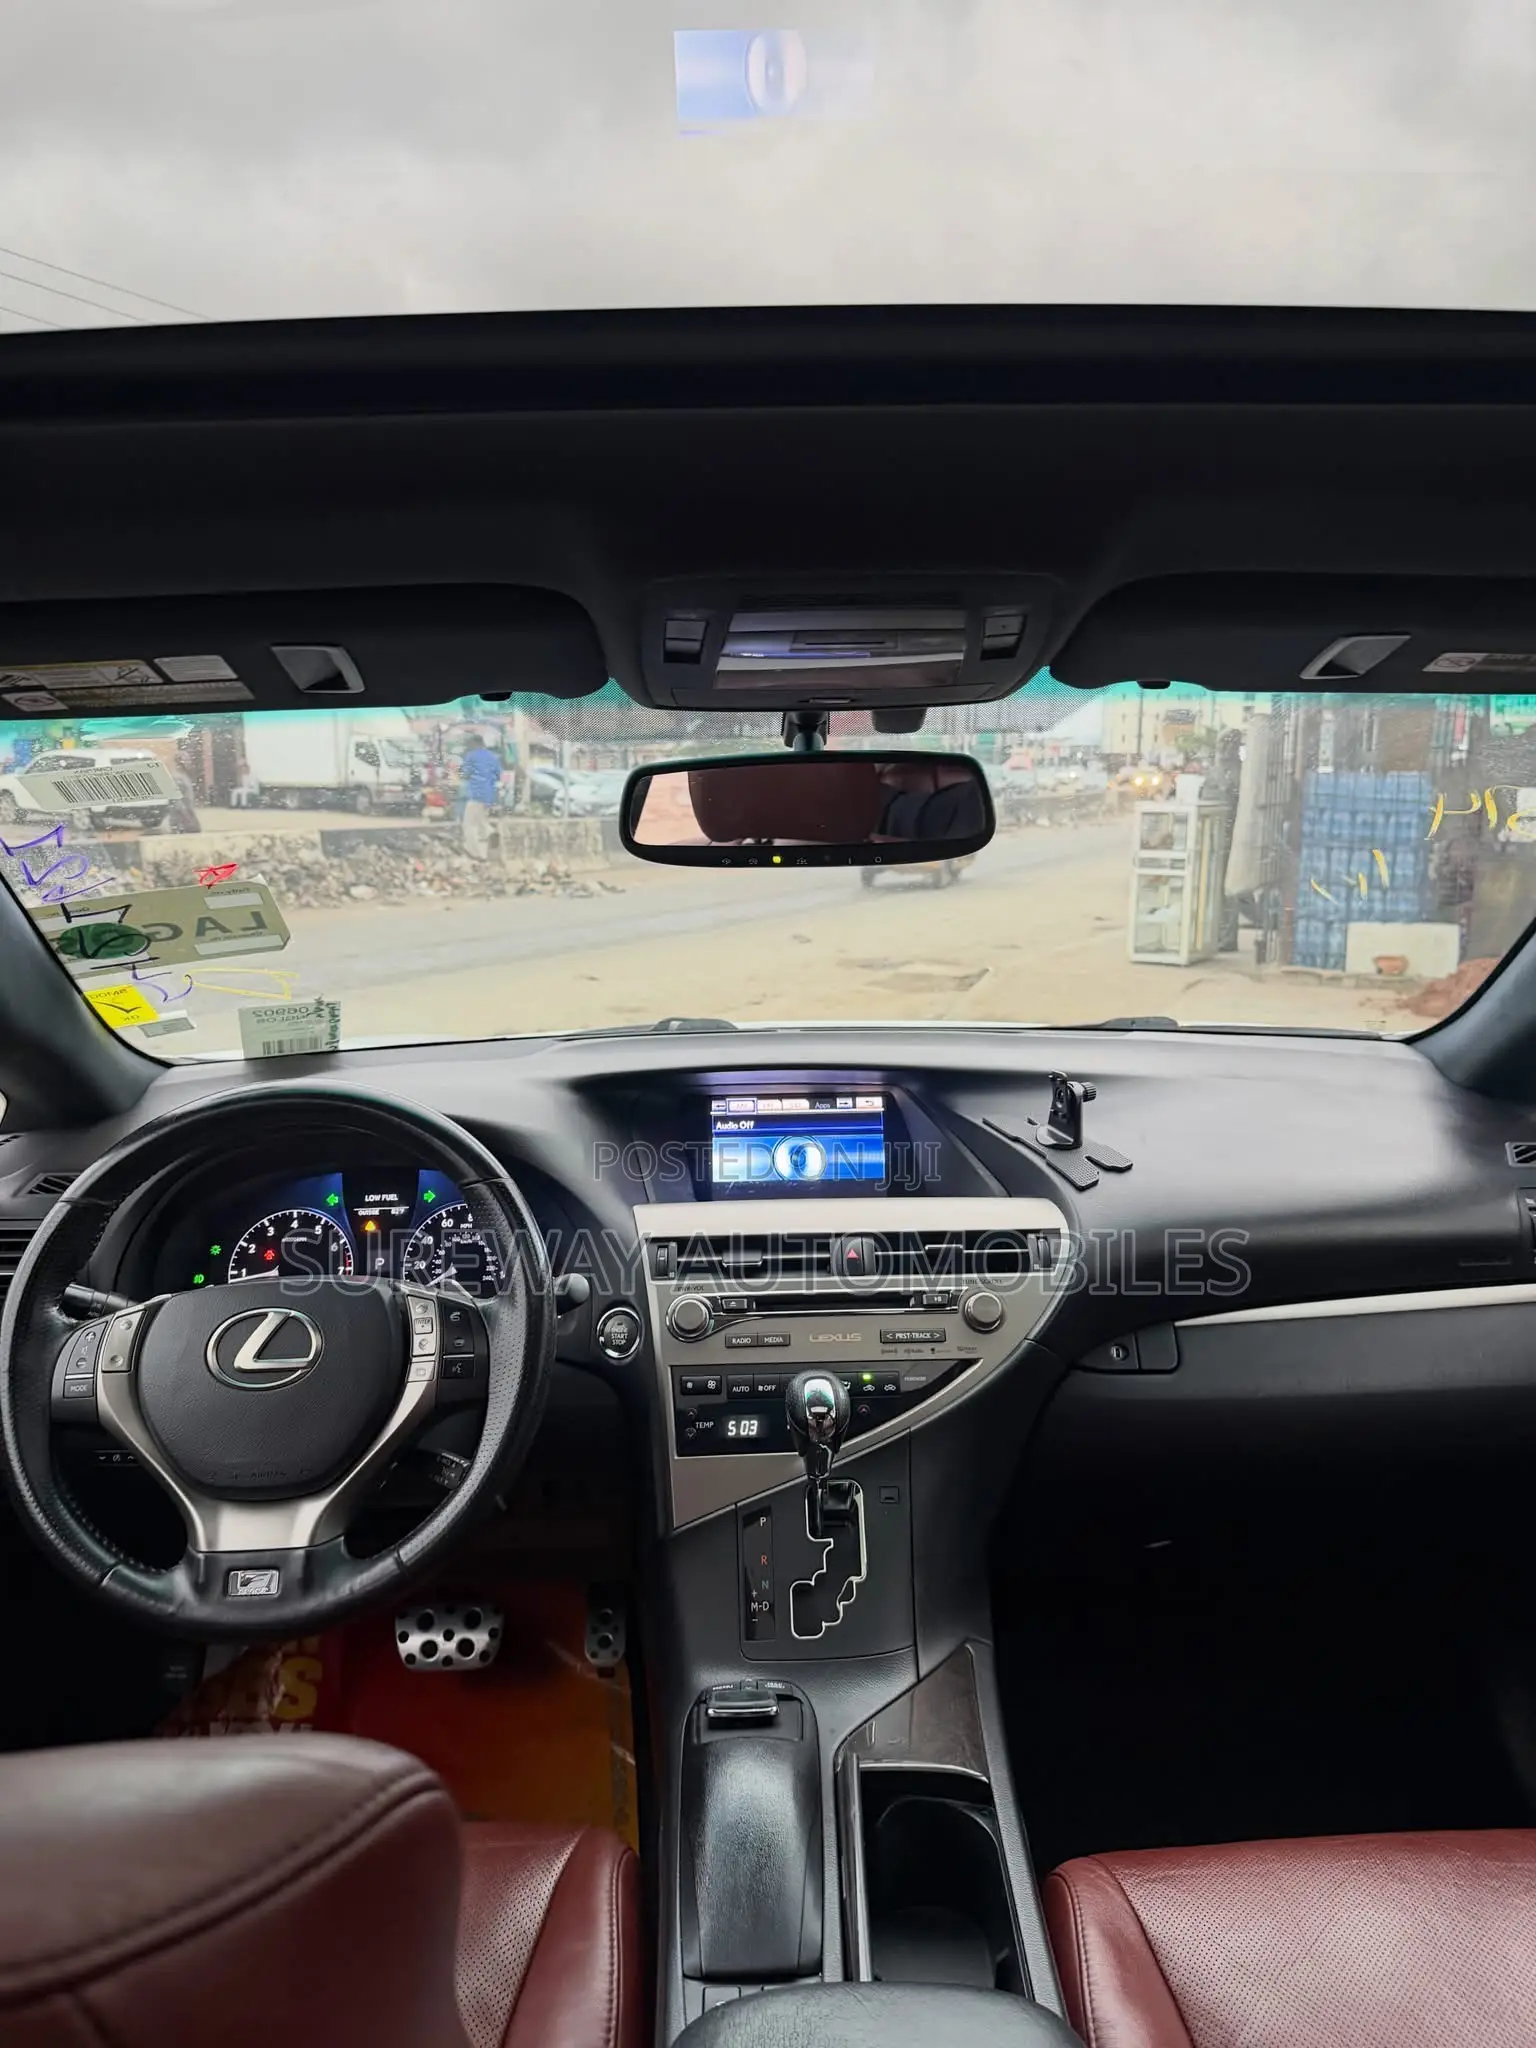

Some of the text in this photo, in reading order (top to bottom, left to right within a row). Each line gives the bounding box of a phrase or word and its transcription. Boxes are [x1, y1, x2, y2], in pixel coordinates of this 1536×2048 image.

[815, 1102, 830, 1110] Apps
[716, 1120, 755, 1130] Audio Off
[365, 1193, 399, 1202] LOW FUEL
[290, 1219, 299, 1229] 4
[441, 1218, 454, 1228] 60
[266, 1226, 275, 1236] 3
[314, 1225, 322, 1235] 5
[421, 1235, 434, 1245] 40
[247, 1243, 256, 1254] 2
[331, 1242, 339, 1252] 6
[374, 1257, 386, 1270] P
[413, 1261, 426, 1270] 20
[240, 1268, 247, 1278] 1
[337, 1266, 345, 1276] 7
[809, 1332, 862, 1343] LEXUS
[70, 1384, 88, 1392] MODE
[695, 1421, 714, 1429] TEMP
[760, 1516, 767, 1527] P
[760, 1554, 768, 1566] R
[761, 1580, 769, 1590] N
